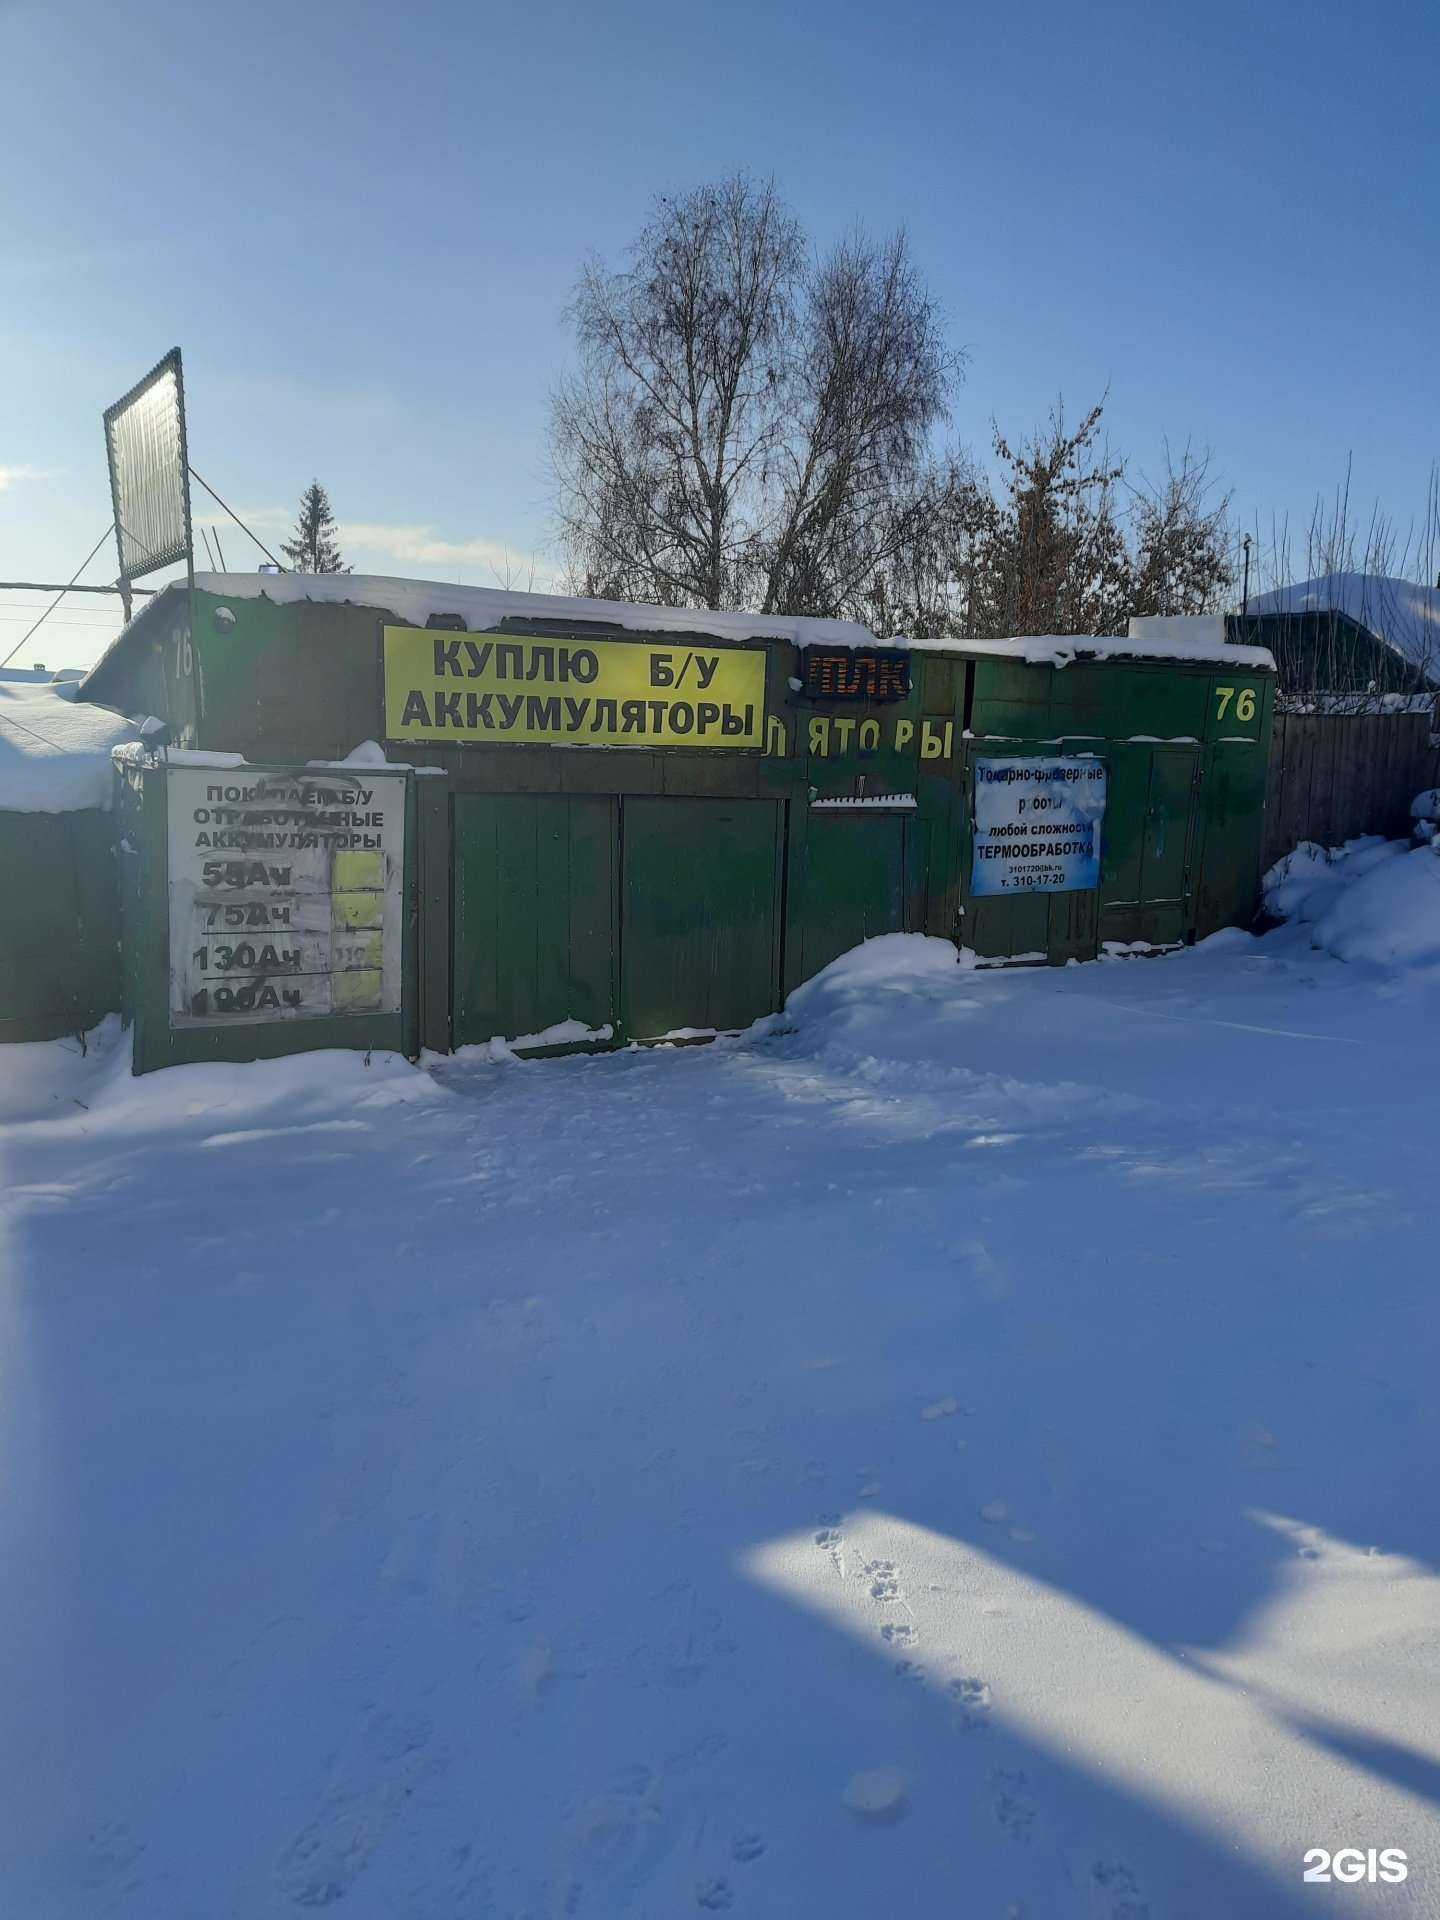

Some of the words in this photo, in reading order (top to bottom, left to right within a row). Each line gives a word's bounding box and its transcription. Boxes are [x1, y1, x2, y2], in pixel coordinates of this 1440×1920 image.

[433, 639, 599, 684] КУПЛЮ
[649, 652, 720, 689] Б/У
[400, 690, 754, 736] АККУМУЛЯТОРЫ
[1215, 687, 1256, 721] 76
[342, 790, 374, 806] Б/У
[1019, 797, 1062, 814] рботы
[989, 823, 1028, 837] любой
[977, 841, 1094, 860] ТЕРМООБРАБОТКА
[1013, 873, 1065, 887] 310-17-20
[202, 902, 290, 926] 75Ач
[193, 944, 301, 971] 130Ач
